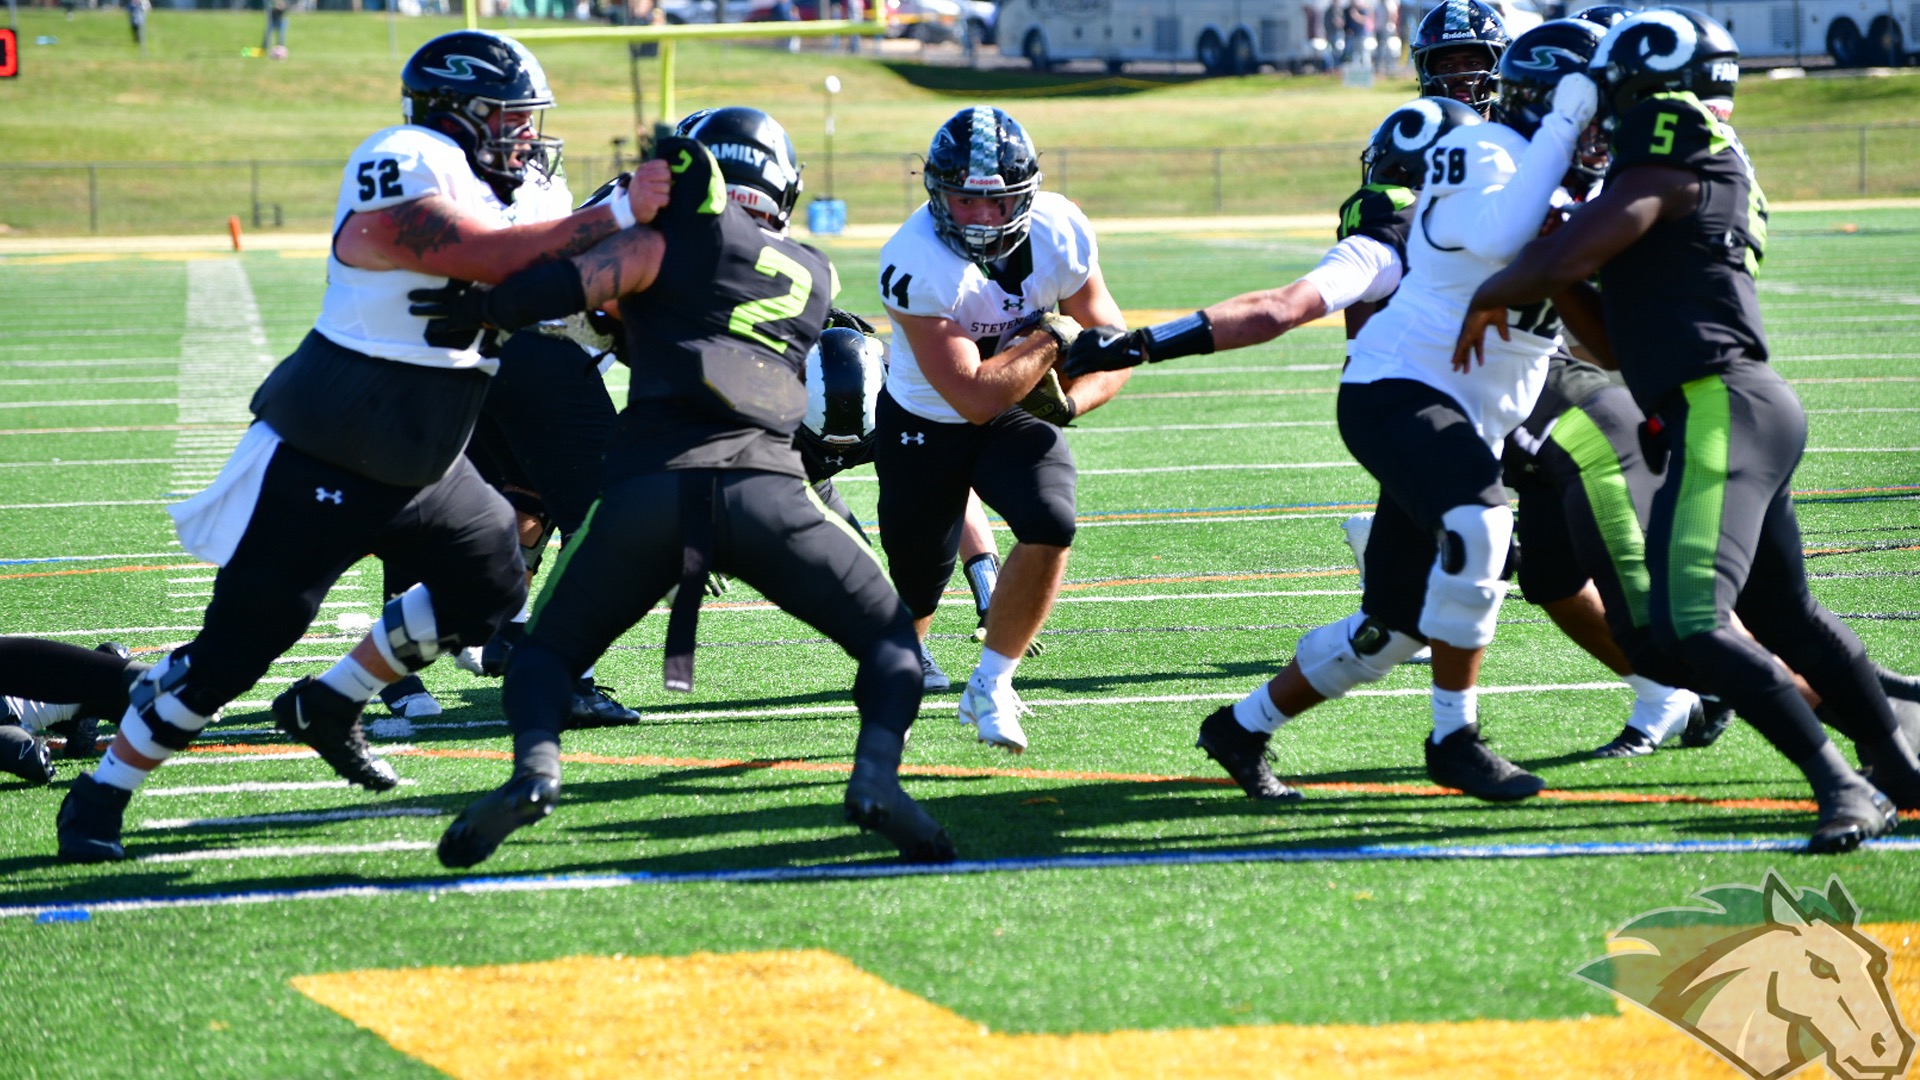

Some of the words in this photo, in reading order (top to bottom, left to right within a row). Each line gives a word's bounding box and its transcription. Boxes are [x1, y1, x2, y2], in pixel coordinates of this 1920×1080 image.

[1711, 62, 1739, 82] FAM
[1650, 112, 1678, 155] 5
[357, 159, 404, 202] 52
[1431, 147, 1466, 185] 58
[727, 188, 759, 206] dell
[728, 245, 813, 354] 2
[880, 263, 913, 309] 44
